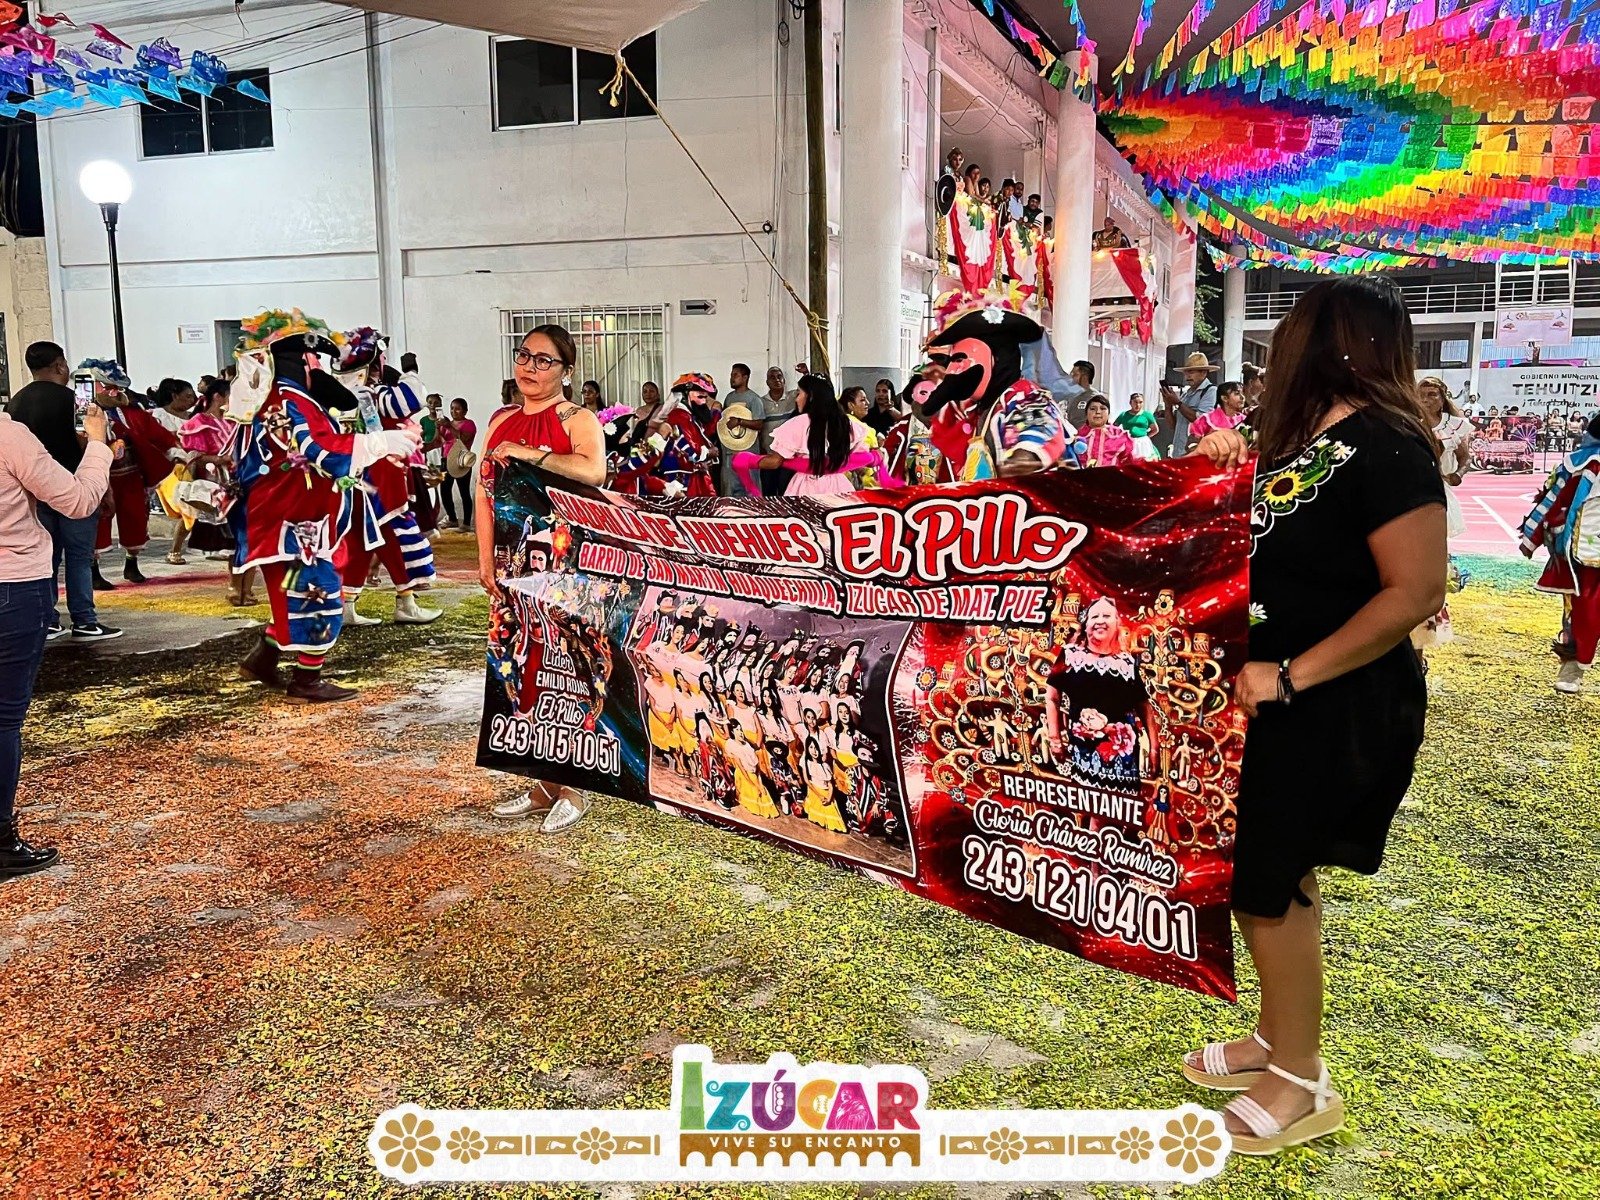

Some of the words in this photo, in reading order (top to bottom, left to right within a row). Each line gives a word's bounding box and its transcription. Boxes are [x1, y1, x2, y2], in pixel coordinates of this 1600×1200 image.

[549, 490, 644, 545] CUADRILLA
[645, 511, 680, 549] DE
[684, 519, 818, 566] HUEHUES
[832, 511, 905, 574] El
[913, 499, 1079, 577] Pillo
[579, 543, 626, 577] BARRIO
[626, 552, 646, 579] DE
[647, 556, 675, 587] SAN
[675, 561, 728, 595] MARTÍN
[727, 570, 842, 613] HUAQUECHULA,
[848, 580, 917, 617] IZÚCAR
[916, 590, 948, 619] DE
[949, 586, 999, 622] MAT.
[1000, 586, 1048, 625] PUE.
[535, 671, 566, 691] EMILIO
[566, 674, 591, 697] ROJAS
[538, 694, 555, 722] El
[556, 697, 584, 727] Pillo
[492, 717, 529, 752] 243
[534, 724, 570, 763] 115
[574, 731, 596, 768] 10
[598, 736, 620, 775] 51
[977, 801, 1033, 837] Gloria
[1035, 814, 1099, 856] Chávez
[1003, 774, 1144, 827] REPRESENTANTE
[967, 838, 1024, 898] 243
[1035, 859, 1091, 922] 121
[1096, 879, 1138, 941] 94
[1143, 898, 1193, 956] 01
